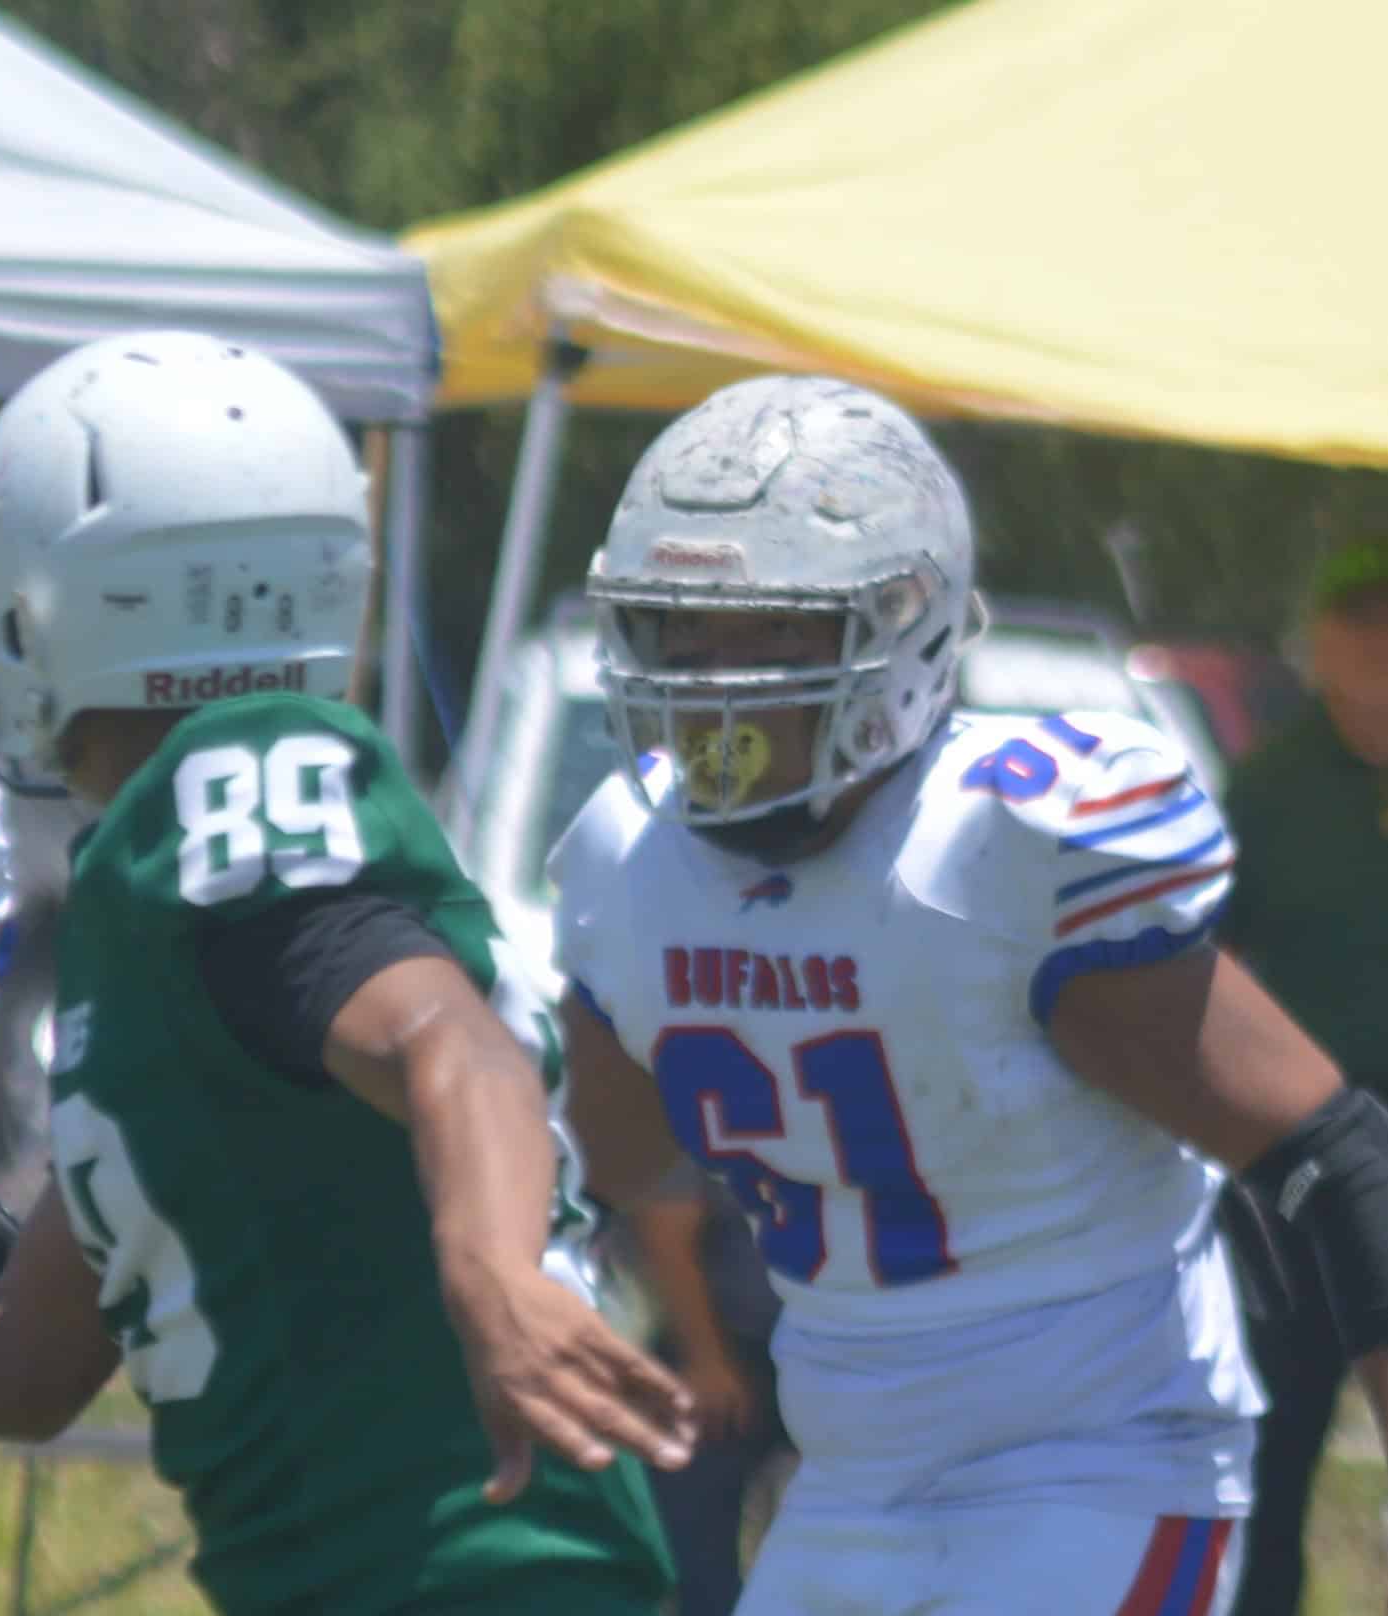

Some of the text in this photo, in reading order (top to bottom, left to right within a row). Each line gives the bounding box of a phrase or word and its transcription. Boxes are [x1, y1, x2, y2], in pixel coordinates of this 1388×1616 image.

[144, 660, 308, 705] Riddell
[172, 734, 365, 907] 89
[662, 945, 860, 1013] BUFALOS
[651, 1025, 960, 1289] 61
